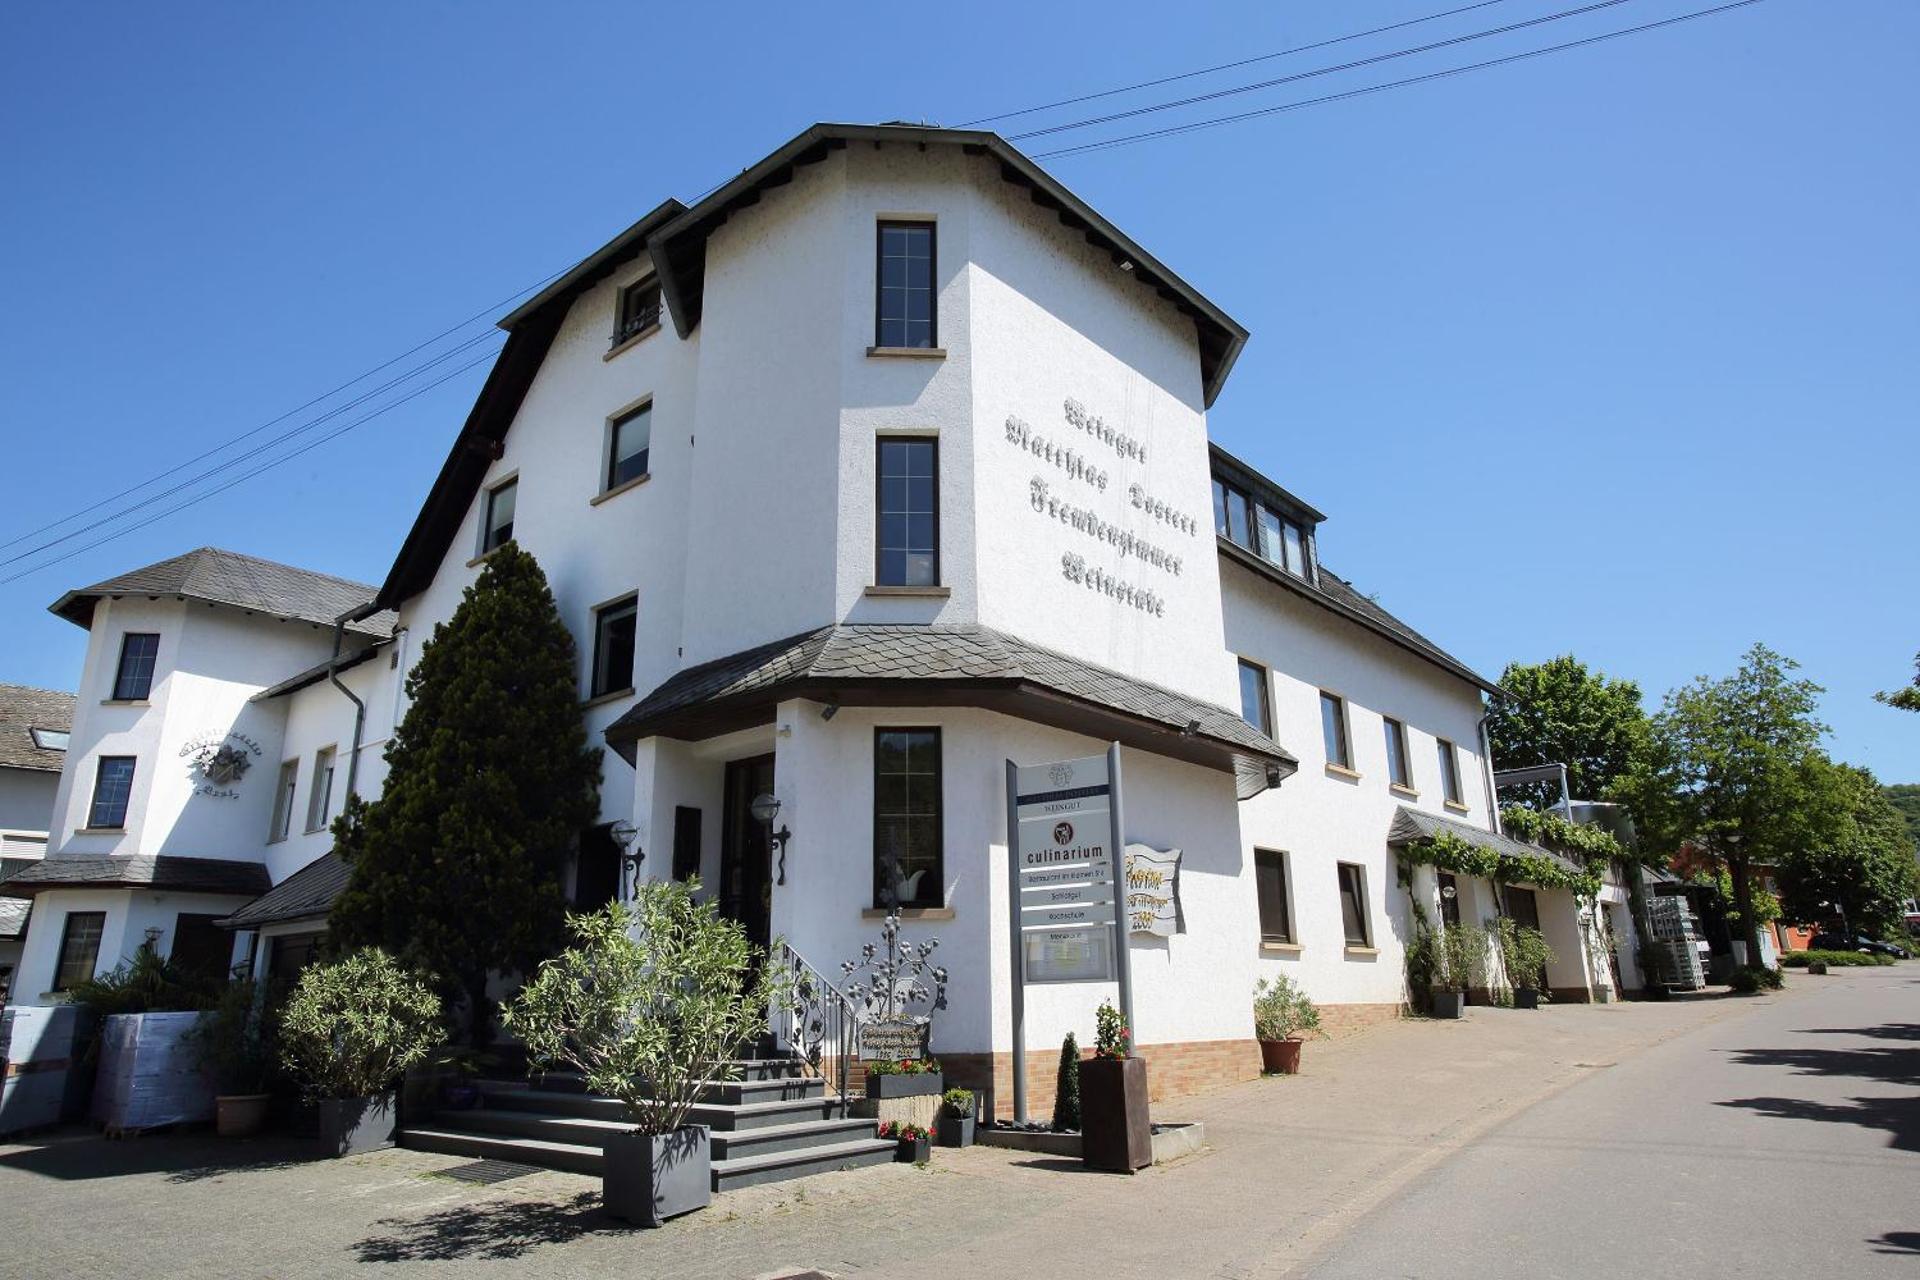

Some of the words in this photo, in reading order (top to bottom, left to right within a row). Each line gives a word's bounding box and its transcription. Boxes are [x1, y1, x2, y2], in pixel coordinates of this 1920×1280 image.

[1064, 396, 1147, 464] Weingut
[1005, 414, 1109, 493] Matthias
[1128, 482, 1198, 538] Dostert
[1030, 474, 1184, 577] Fremdenzimmer
[1061, 550, 1166, 618] Weinstube
[1044, 801, 1081, 812] WEINGUT
[1027, 846, 1103, 864] culinarium
